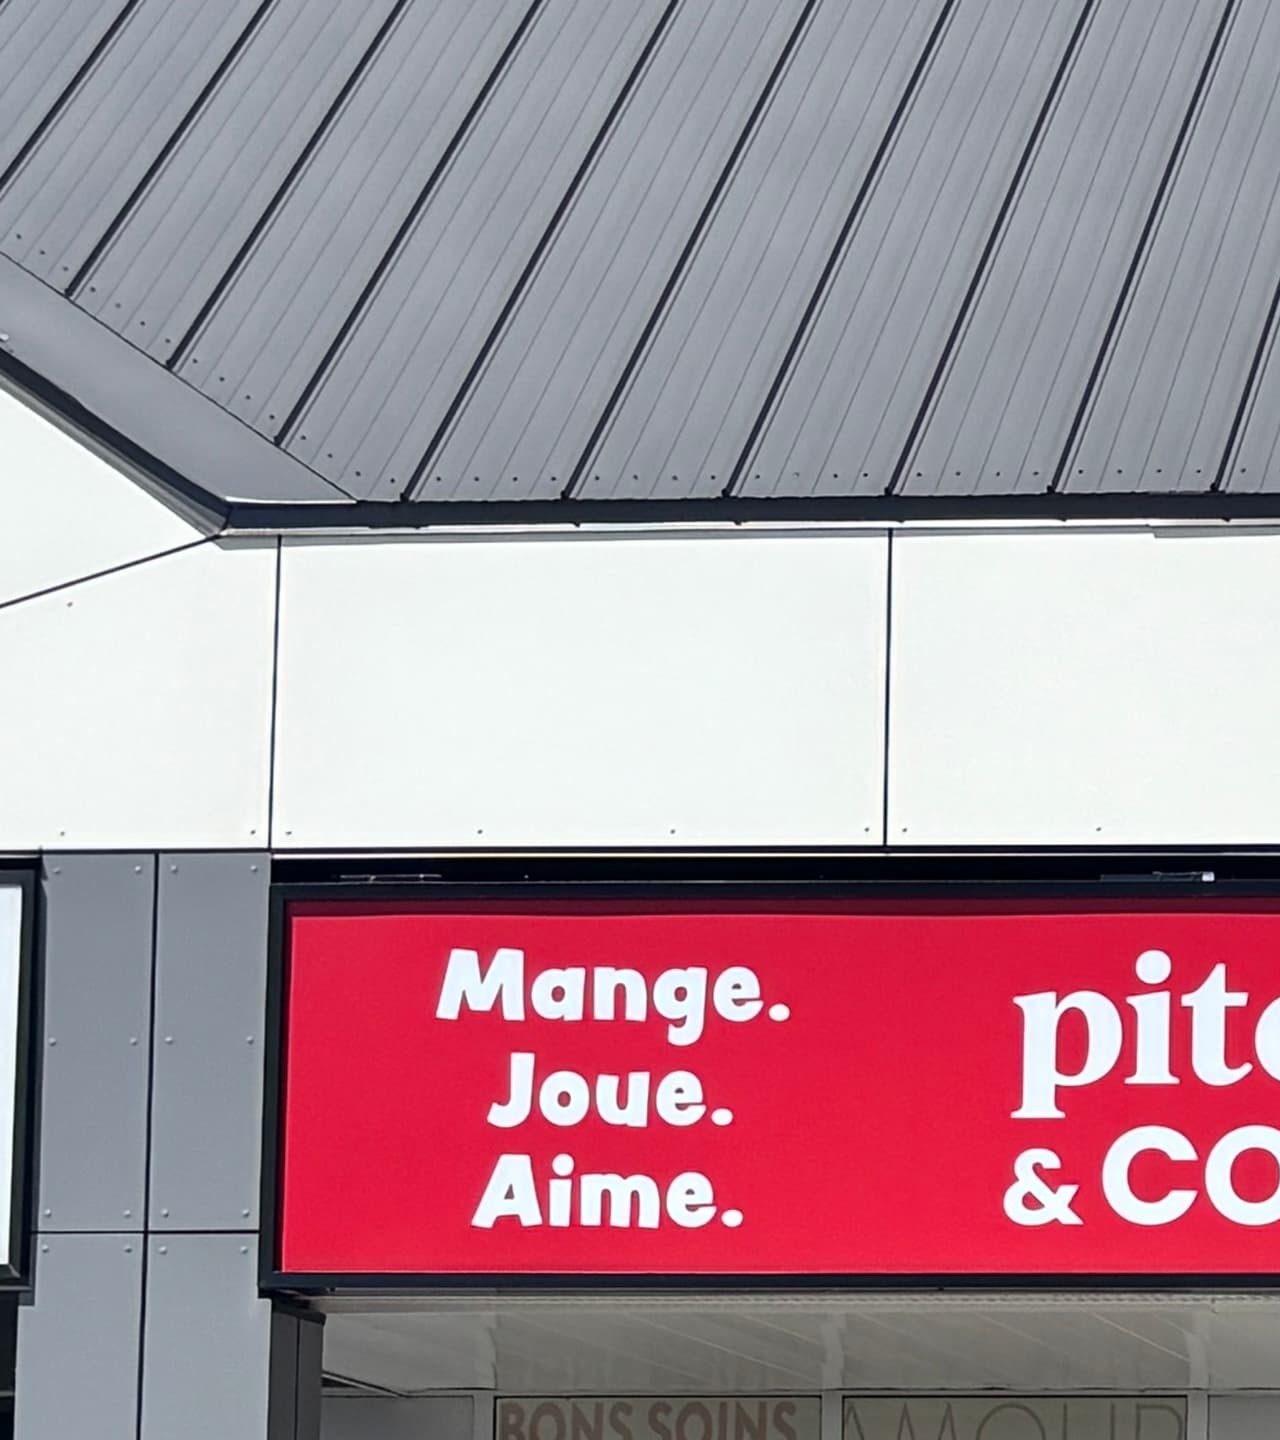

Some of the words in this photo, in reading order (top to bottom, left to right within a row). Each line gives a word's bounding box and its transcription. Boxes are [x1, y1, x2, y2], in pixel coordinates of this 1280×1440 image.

[435, 948, 790, 1046] Mange.
[486, 1052, 733, 1128] Joue.
[471, 1153, 744, 1229] Aime.
[1003, 1148, 1083, 1226] &
